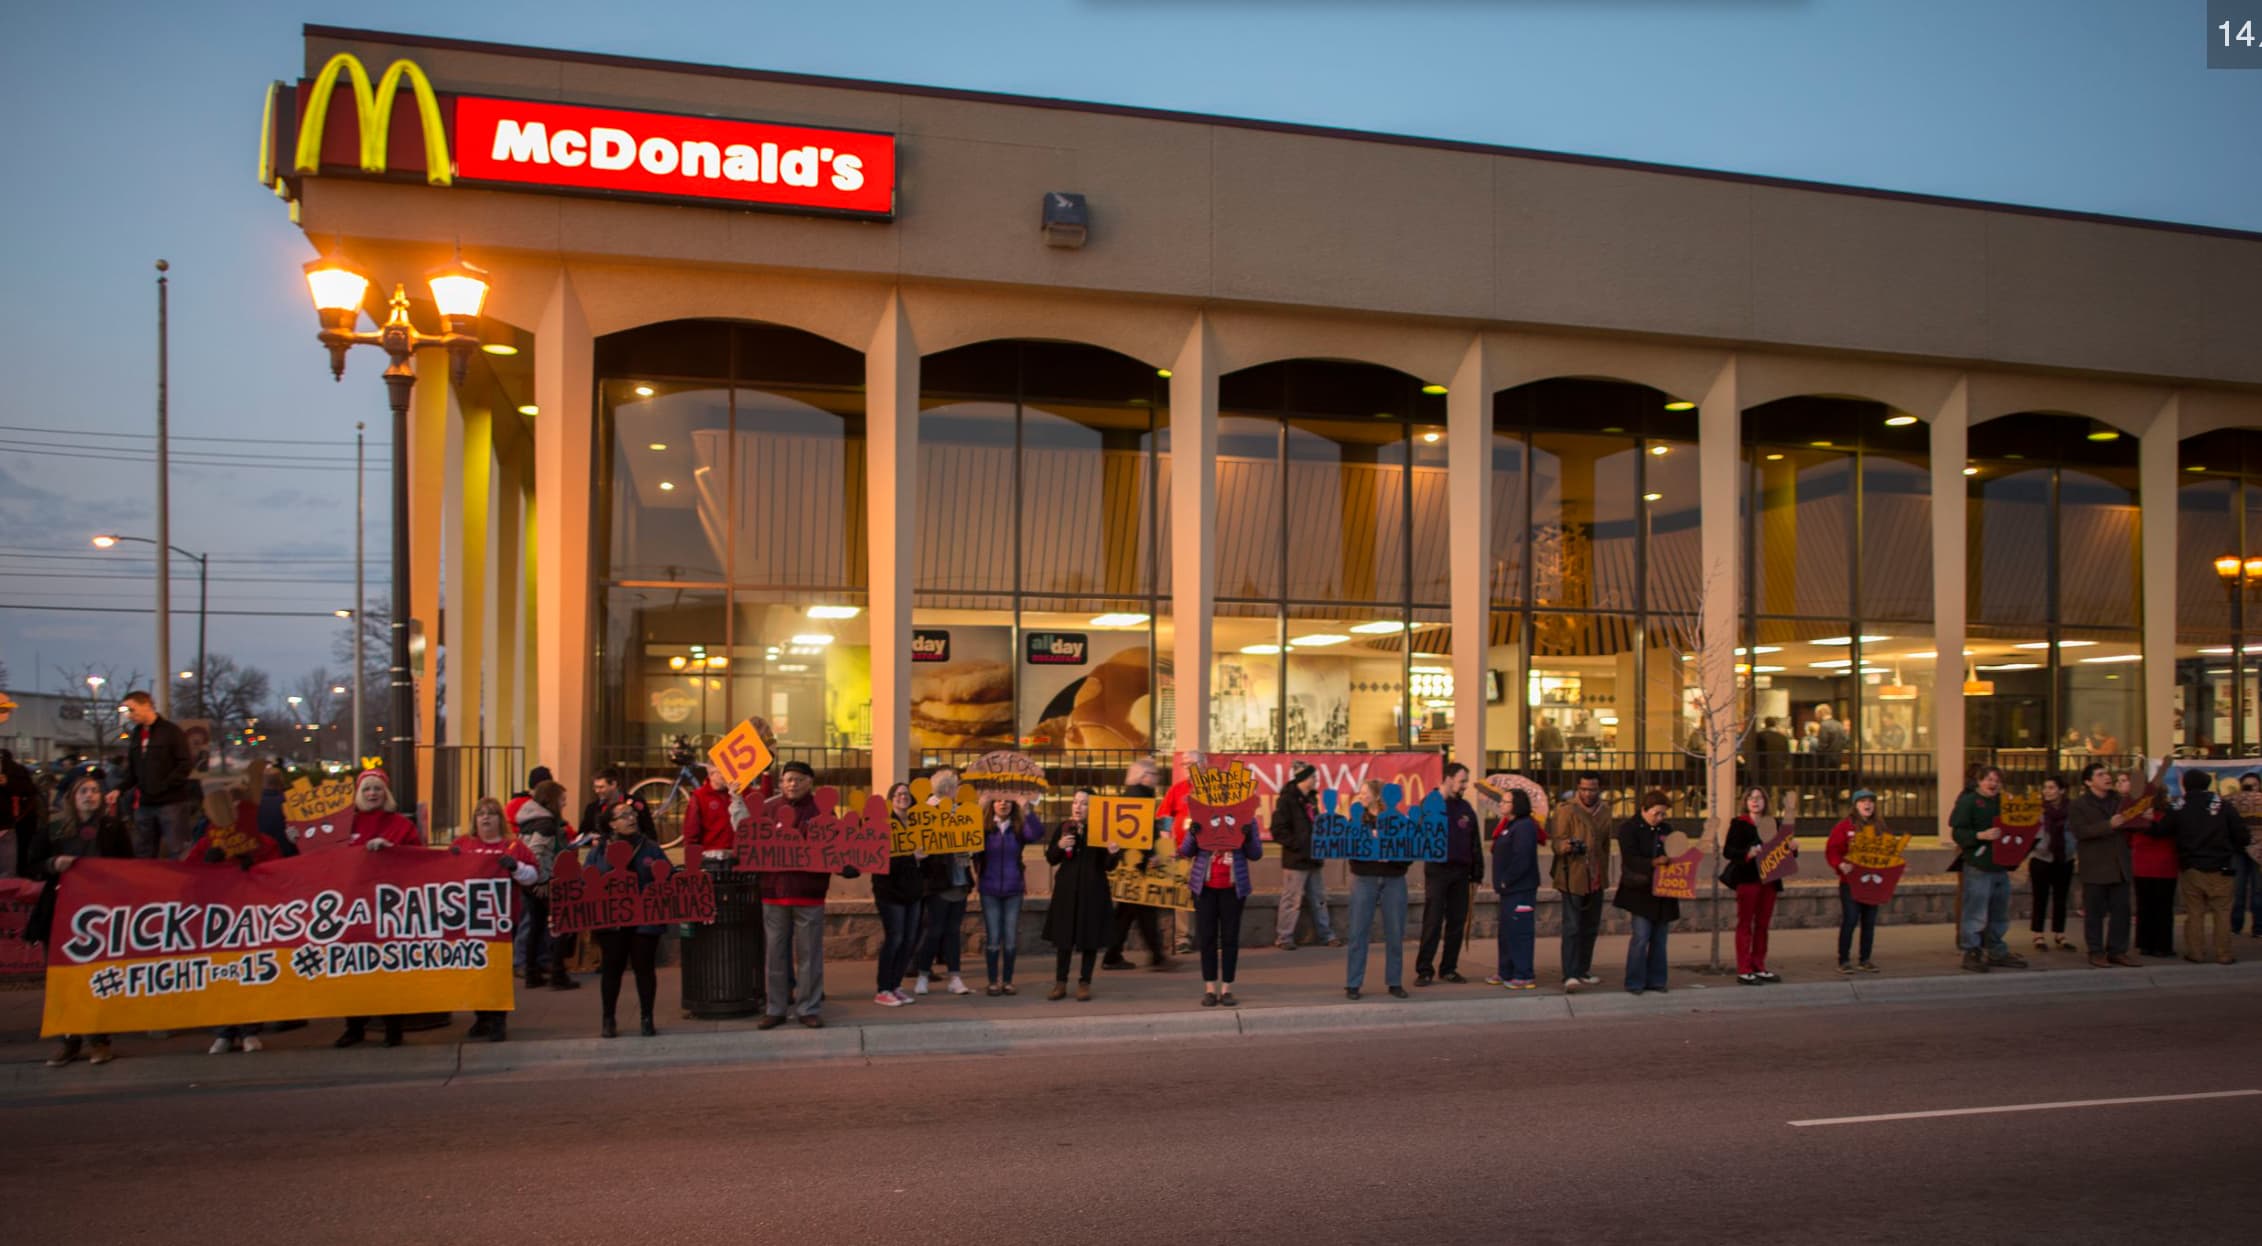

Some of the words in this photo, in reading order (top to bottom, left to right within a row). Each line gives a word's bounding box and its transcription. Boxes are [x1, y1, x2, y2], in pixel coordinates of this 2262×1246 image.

[491, 119, 864, 191] McDonald's
[913, 636, 946, 655] day
[1051, 638, 1083, 657] day
[719, 733, 757, 780] 15
[908, 811, 929, 827] $15
[940, 812, 974, 827] PARA
[1315, 816, 1345, 836] $15
[1407, 820, 1447, 838] PARA
[736, 821, 773, 841] $15
[808, 822, 837, 841] $15
[845, 826, 888, 841] PARA
[921, 828, 982, 851] FAMILIAS
[736, 844, 811, 867] FAMILIES
[822, 845, 886, 869] FAMILIAS
[1313, 839, 1373, 857] FAMILIES
[1380, 839, 1447, 859] FAMILIAS
[1659, 861, 1692, 876] FAST
[551, 878, 585, 903] $15
[608, 876, 637, 895] FOR
[650, 882, 675, 897] $15
[677, 873, 713, 895] PARA
[1658, 877, 1687, 888] FOOD
[62, 902, 202, 962] SICK
[202, 898, 307, 949] DAYS
[306, 889, 345, 943] &
[346, 899, 371, 925] A
[376, 878, 513, 938] RAISE!
[552, 898, 635, 932] FAMILIES
[643, 893, 715, 923] FAMILIAS
[290, 939, 488, 980] #PAIDSICKDAYS
